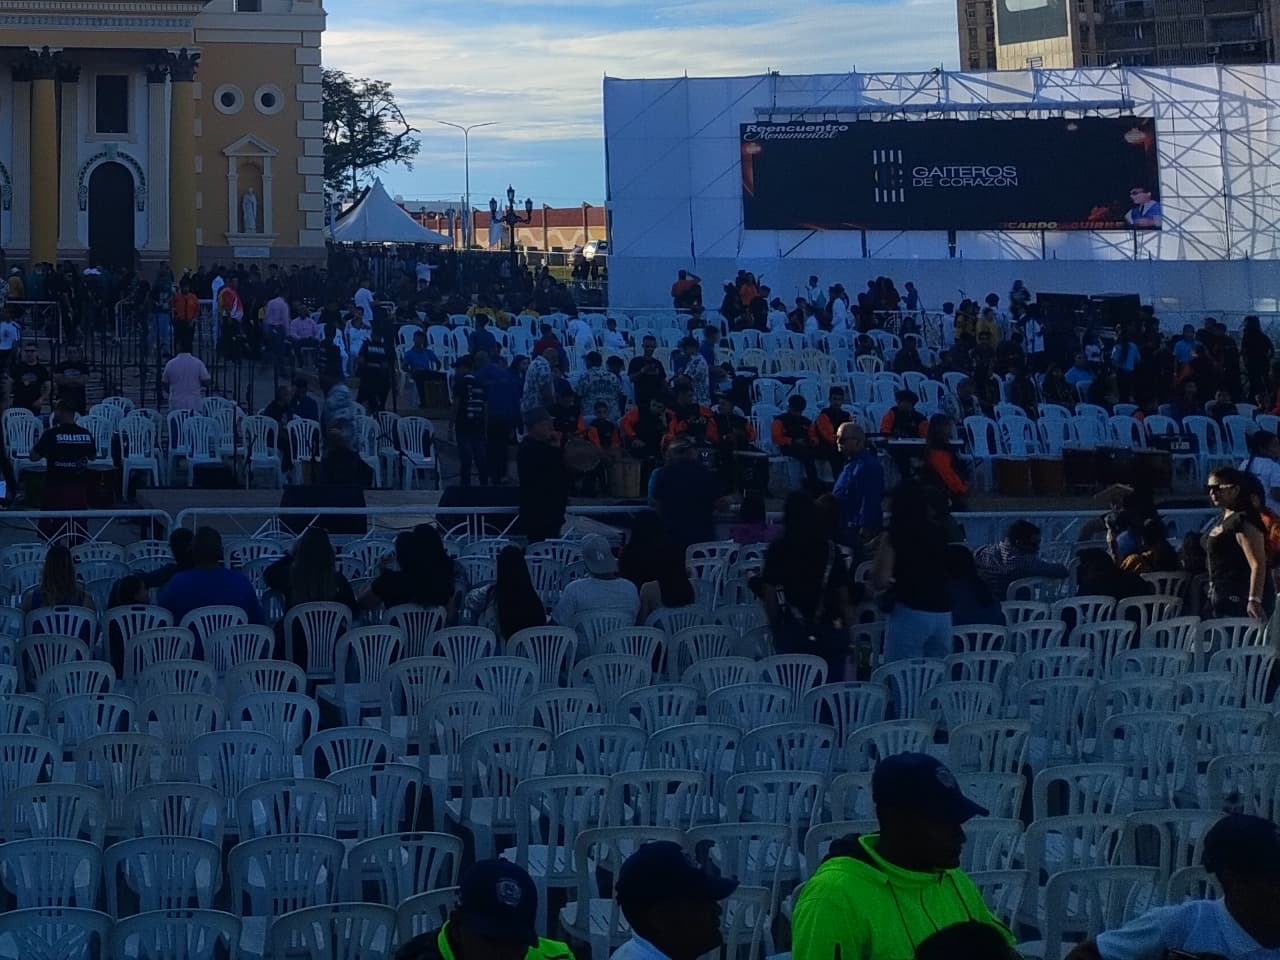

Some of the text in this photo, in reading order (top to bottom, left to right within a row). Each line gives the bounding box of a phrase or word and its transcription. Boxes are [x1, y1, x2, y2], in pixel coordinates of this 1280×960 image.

[745, 124, 849, 133] Reencuentro
[912, 165, 1017, 178] GAITEROS
[912, 176, 1018, 187] DE CORAZÓN
